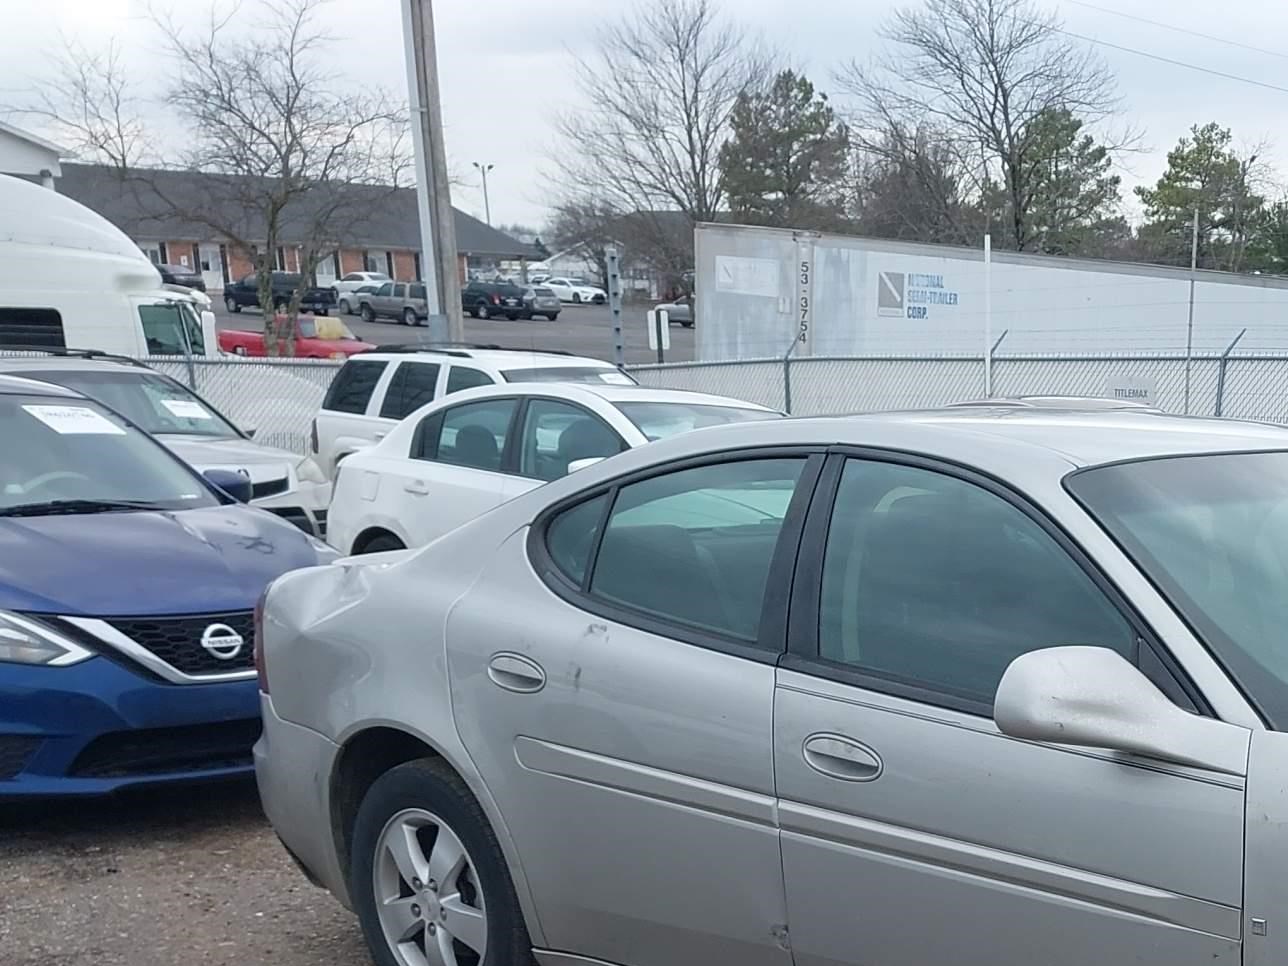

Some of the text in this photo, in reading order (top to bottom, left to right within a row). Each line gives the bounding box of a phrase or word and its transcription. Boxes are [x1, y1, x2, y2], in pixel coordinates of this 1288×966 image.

[800, 261, 809, 344] 53-3754
[907, 306, 928, 320] CORP.
[1114, 388, 1148, 398] TITLEMAX
